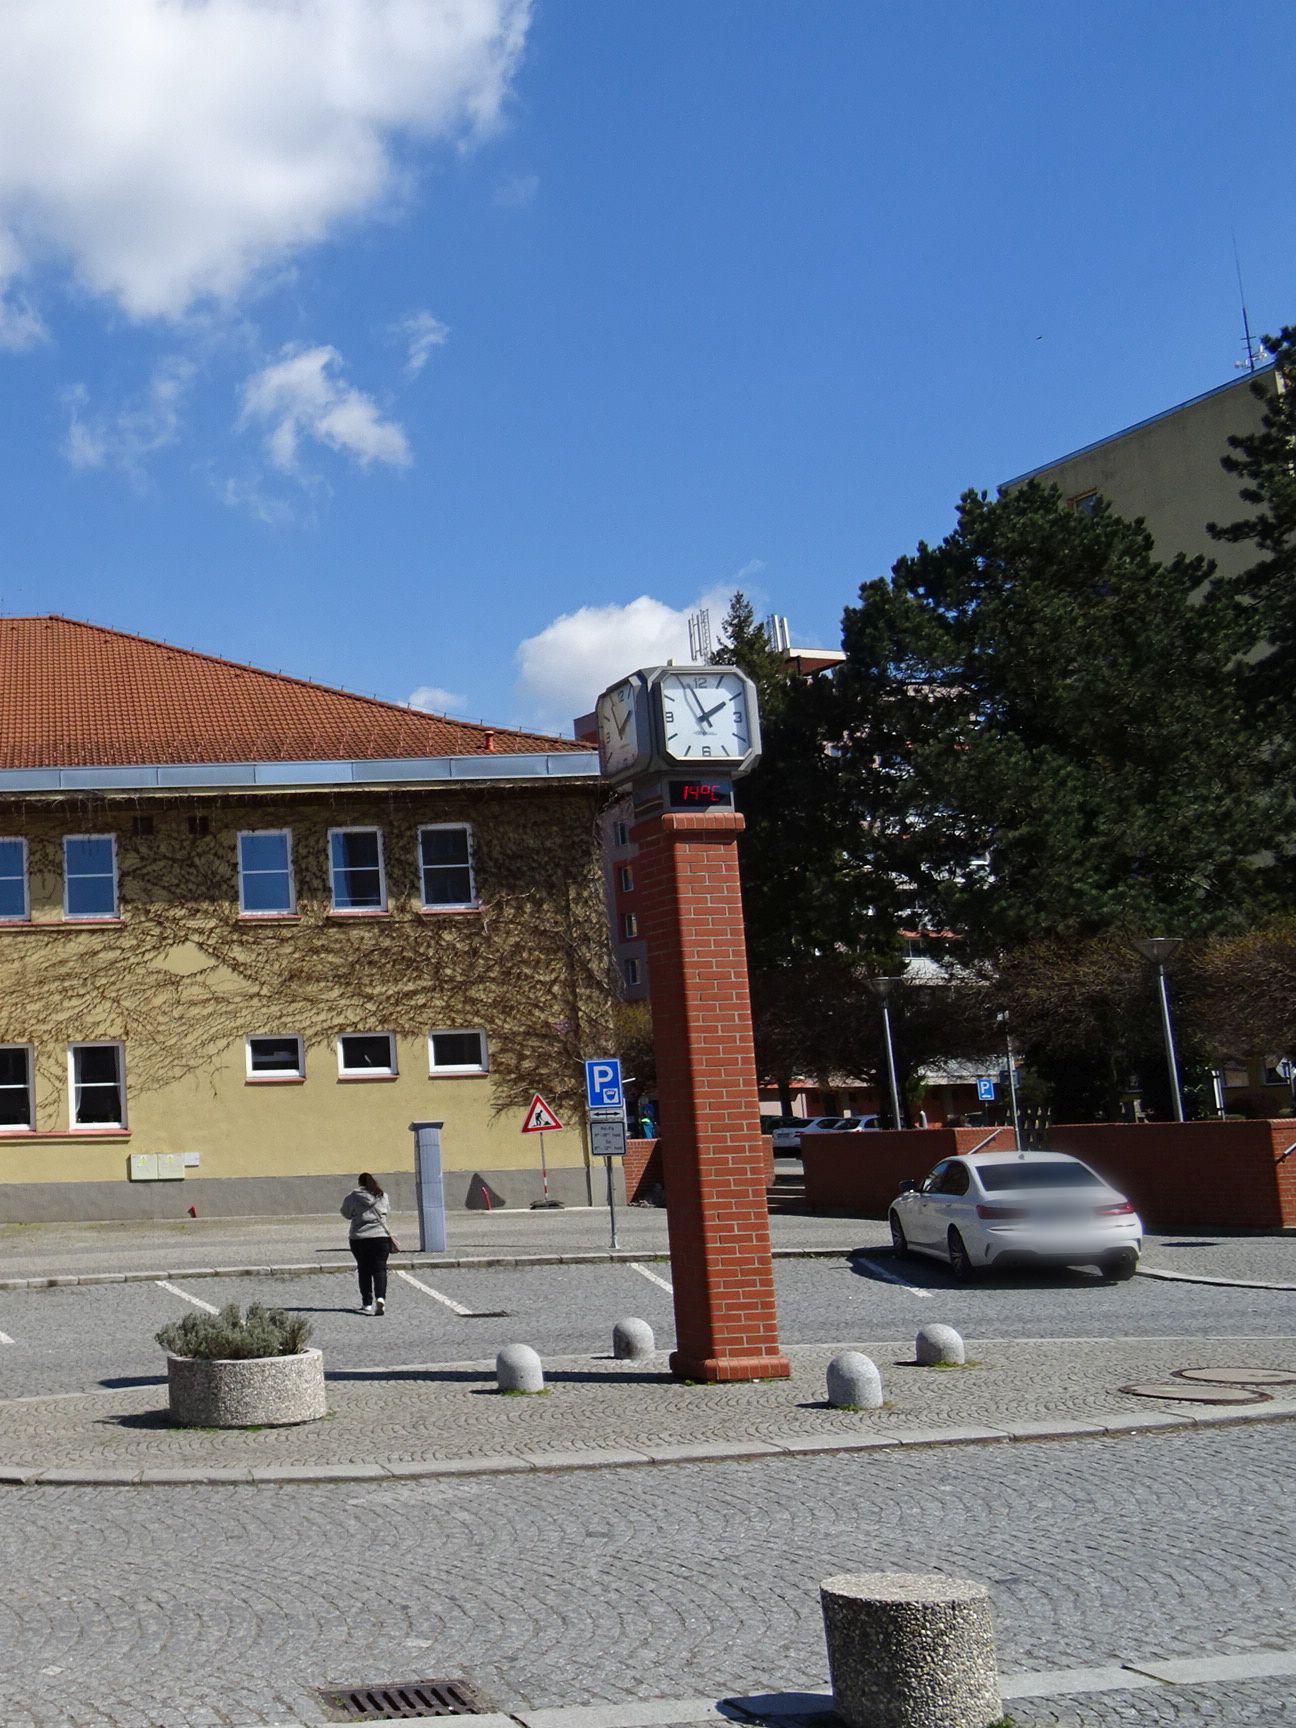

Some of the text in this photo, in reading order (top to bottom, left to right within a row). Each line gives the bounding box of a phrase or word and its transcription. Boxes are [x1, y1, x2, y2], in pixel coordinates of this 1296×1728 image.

[694, 677, 708, 689] 12
[733, 712, 742, 723] 3
[702, 746, 711, 757] 6
[593, 1065, 614, 1093] P
[980, 1081, 990, 1094] P
